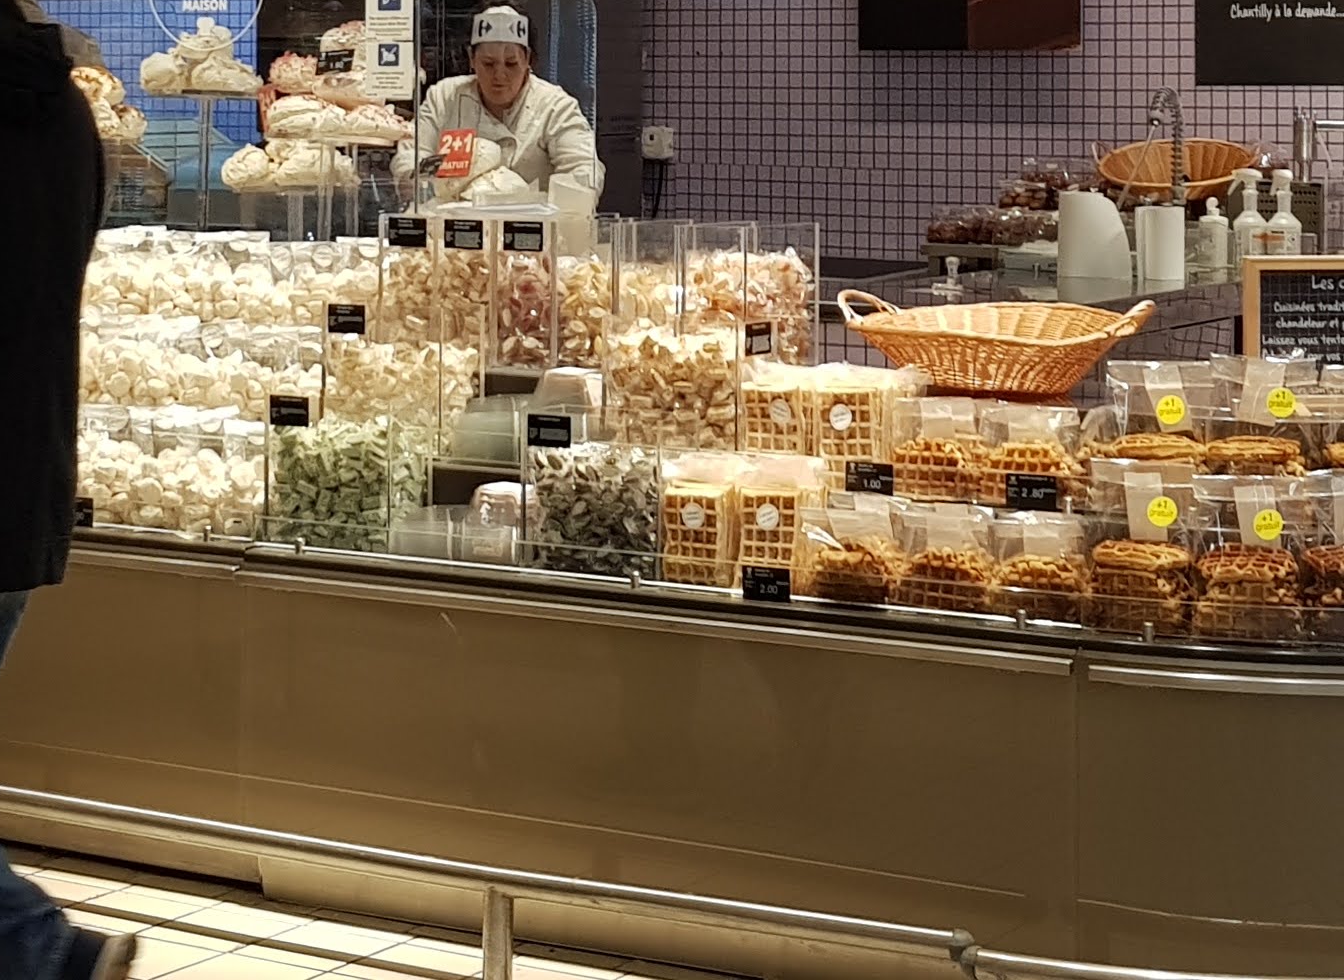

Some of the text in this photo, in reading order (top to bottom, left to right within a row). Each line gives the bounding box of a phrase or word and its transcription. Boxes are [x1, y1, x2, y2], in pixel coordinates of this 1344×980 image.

[1230, 2, 1273, 22] Chantilly
[1274, 3, 1281, 17] à
[1283, 3, 1292, 17] la
[438, 131, 473, 154] 2+1
[1311, 275, 1335, 290] Les
[1329, 317, 1339, 328] et
